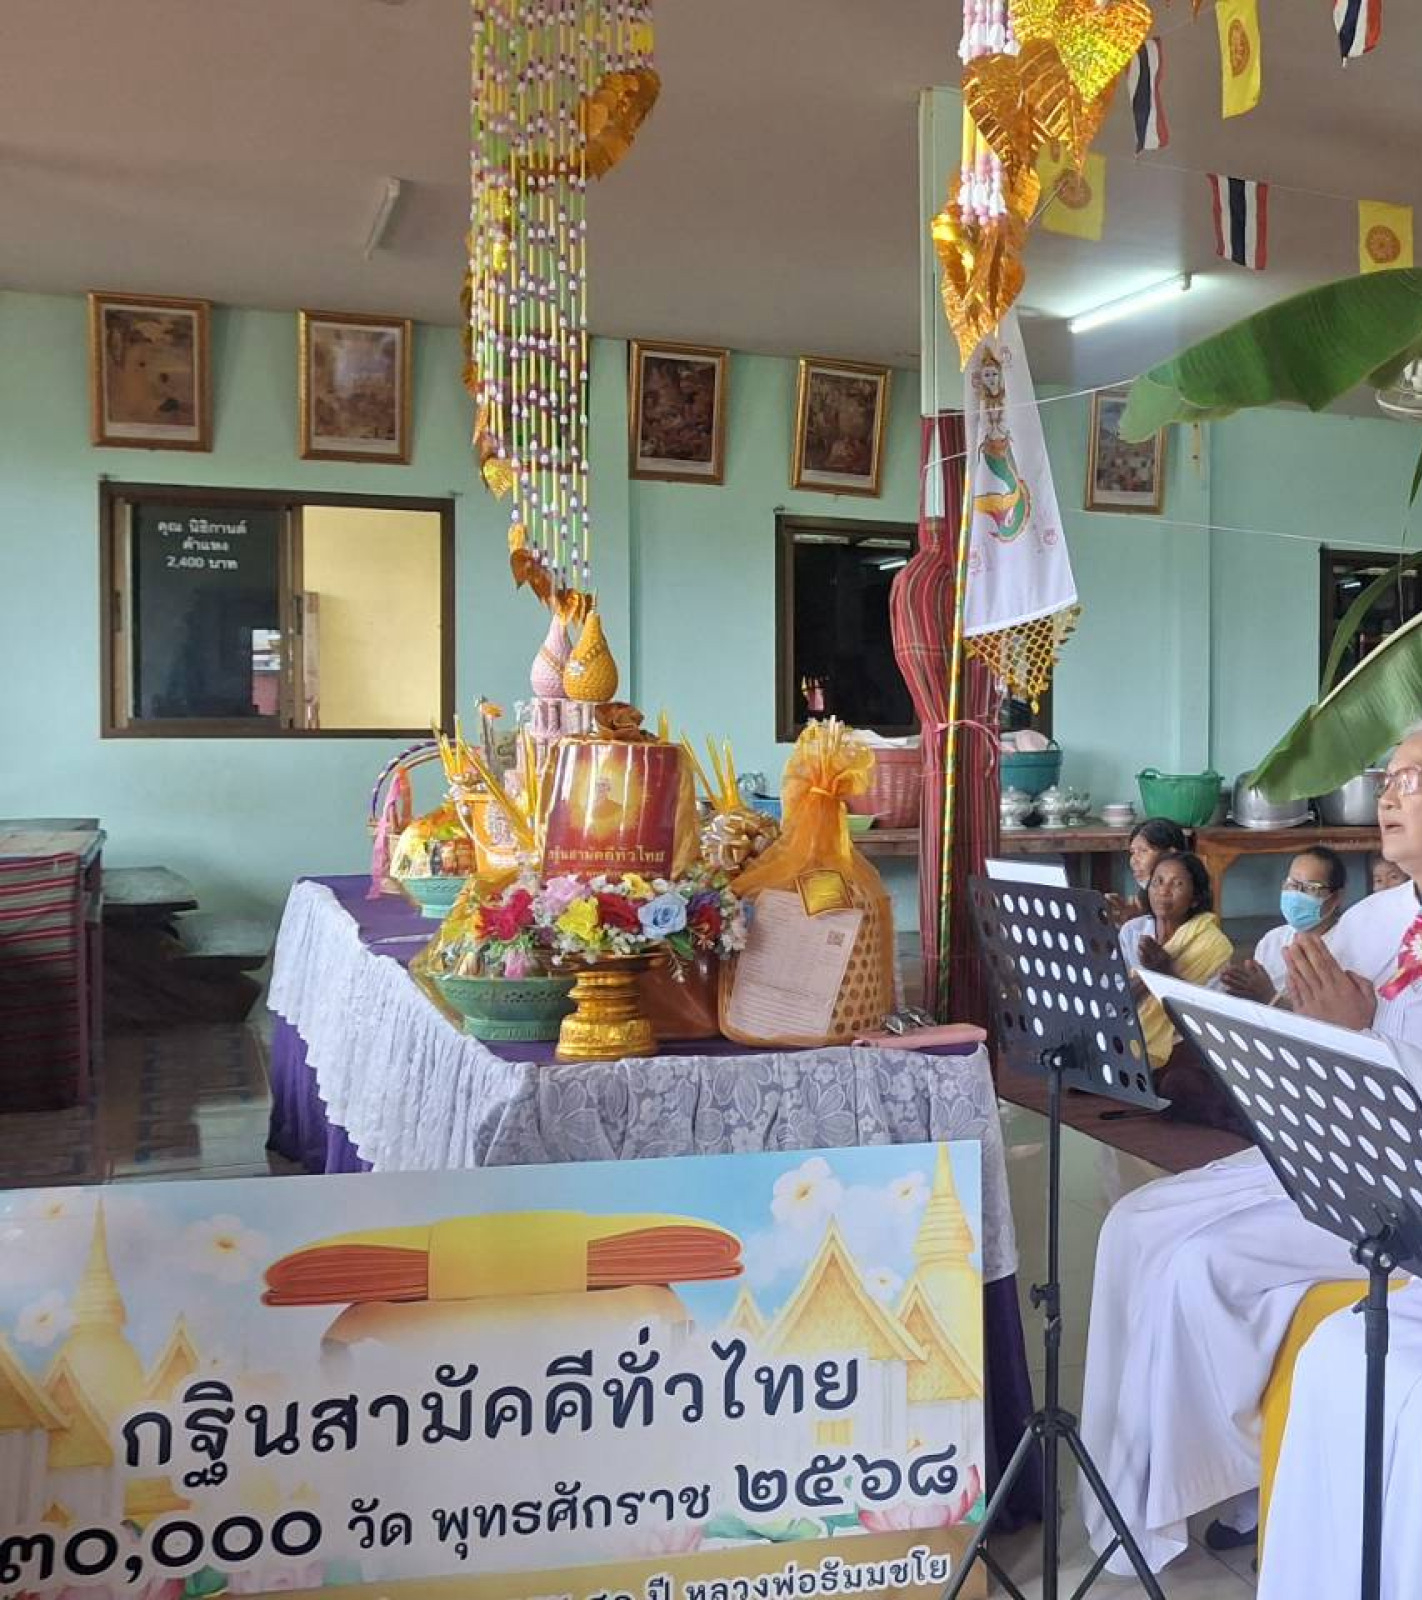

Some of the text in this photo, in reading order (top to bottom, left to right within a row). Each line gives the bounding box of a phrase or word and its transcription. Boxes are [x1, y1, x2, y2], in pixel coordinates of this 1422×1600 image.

[158, 521, 183, 536] คุณ
[166, 555, 239, 570] 2,400 บาท
[122, 1326, 858, 1488] กฐินสามัคคีทั่วไทย
[0, 1444, 959, 1586] ๓๐,๐๐๐ วัด พุทธศักราช ๒๕๖๘
